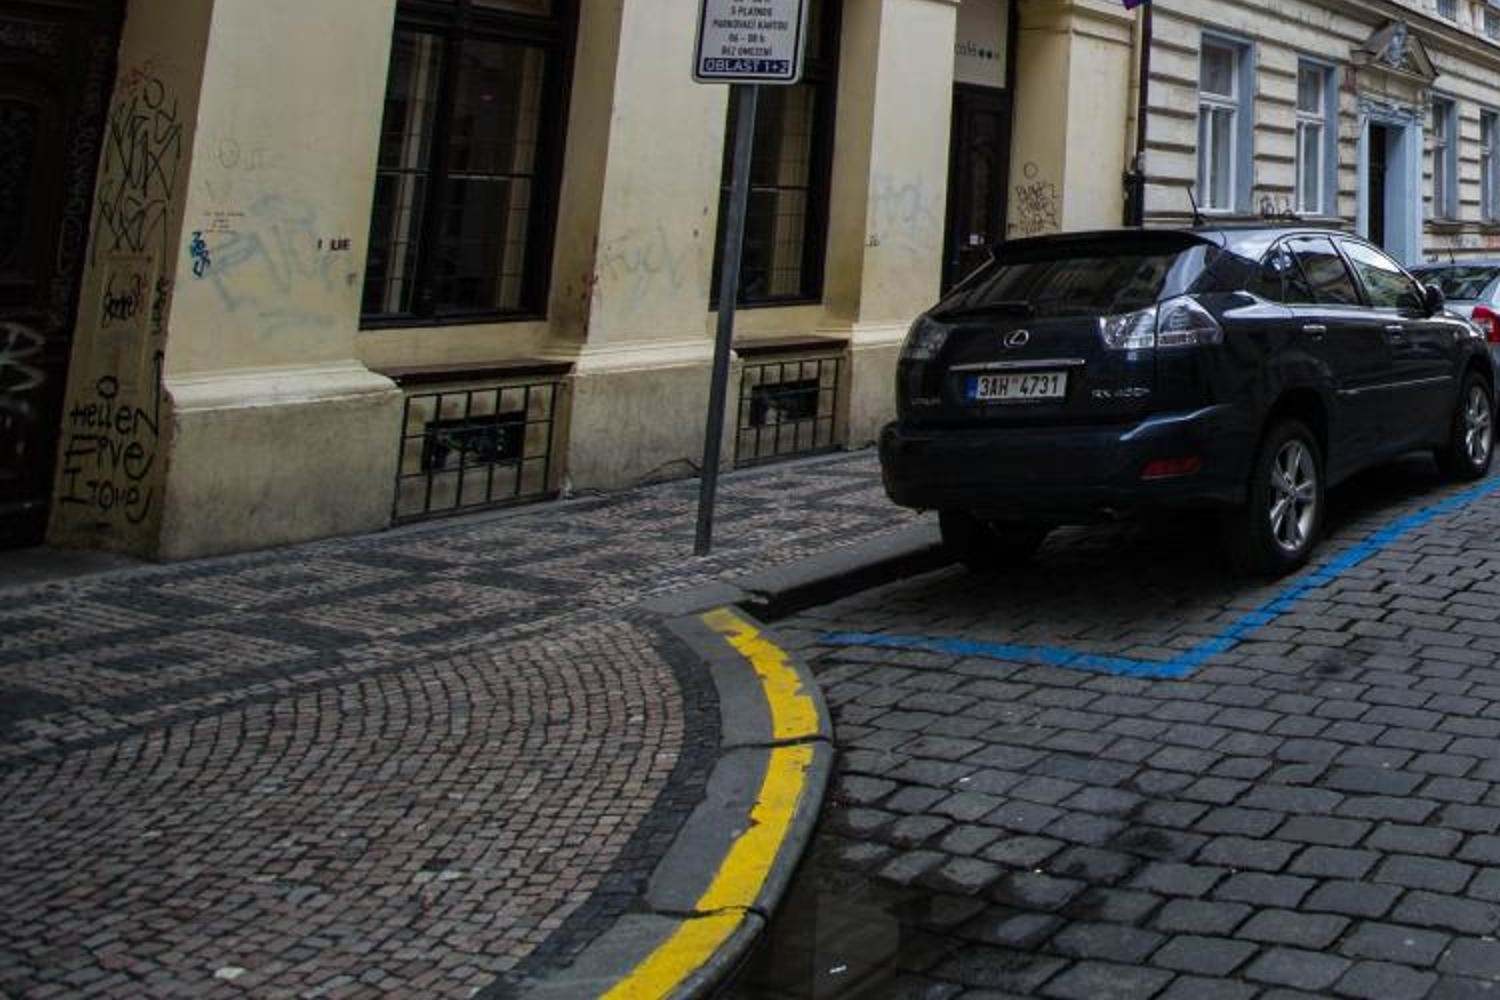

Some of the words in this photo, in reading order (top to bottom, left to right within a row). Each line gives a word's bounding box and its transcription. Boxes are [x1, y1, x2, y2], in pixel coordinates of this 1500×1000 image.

[705, 59, 761, 72] OBLAST
[980, 377, 1008, 397] 3AH
[1020, 374, 1058, 396] 4731
